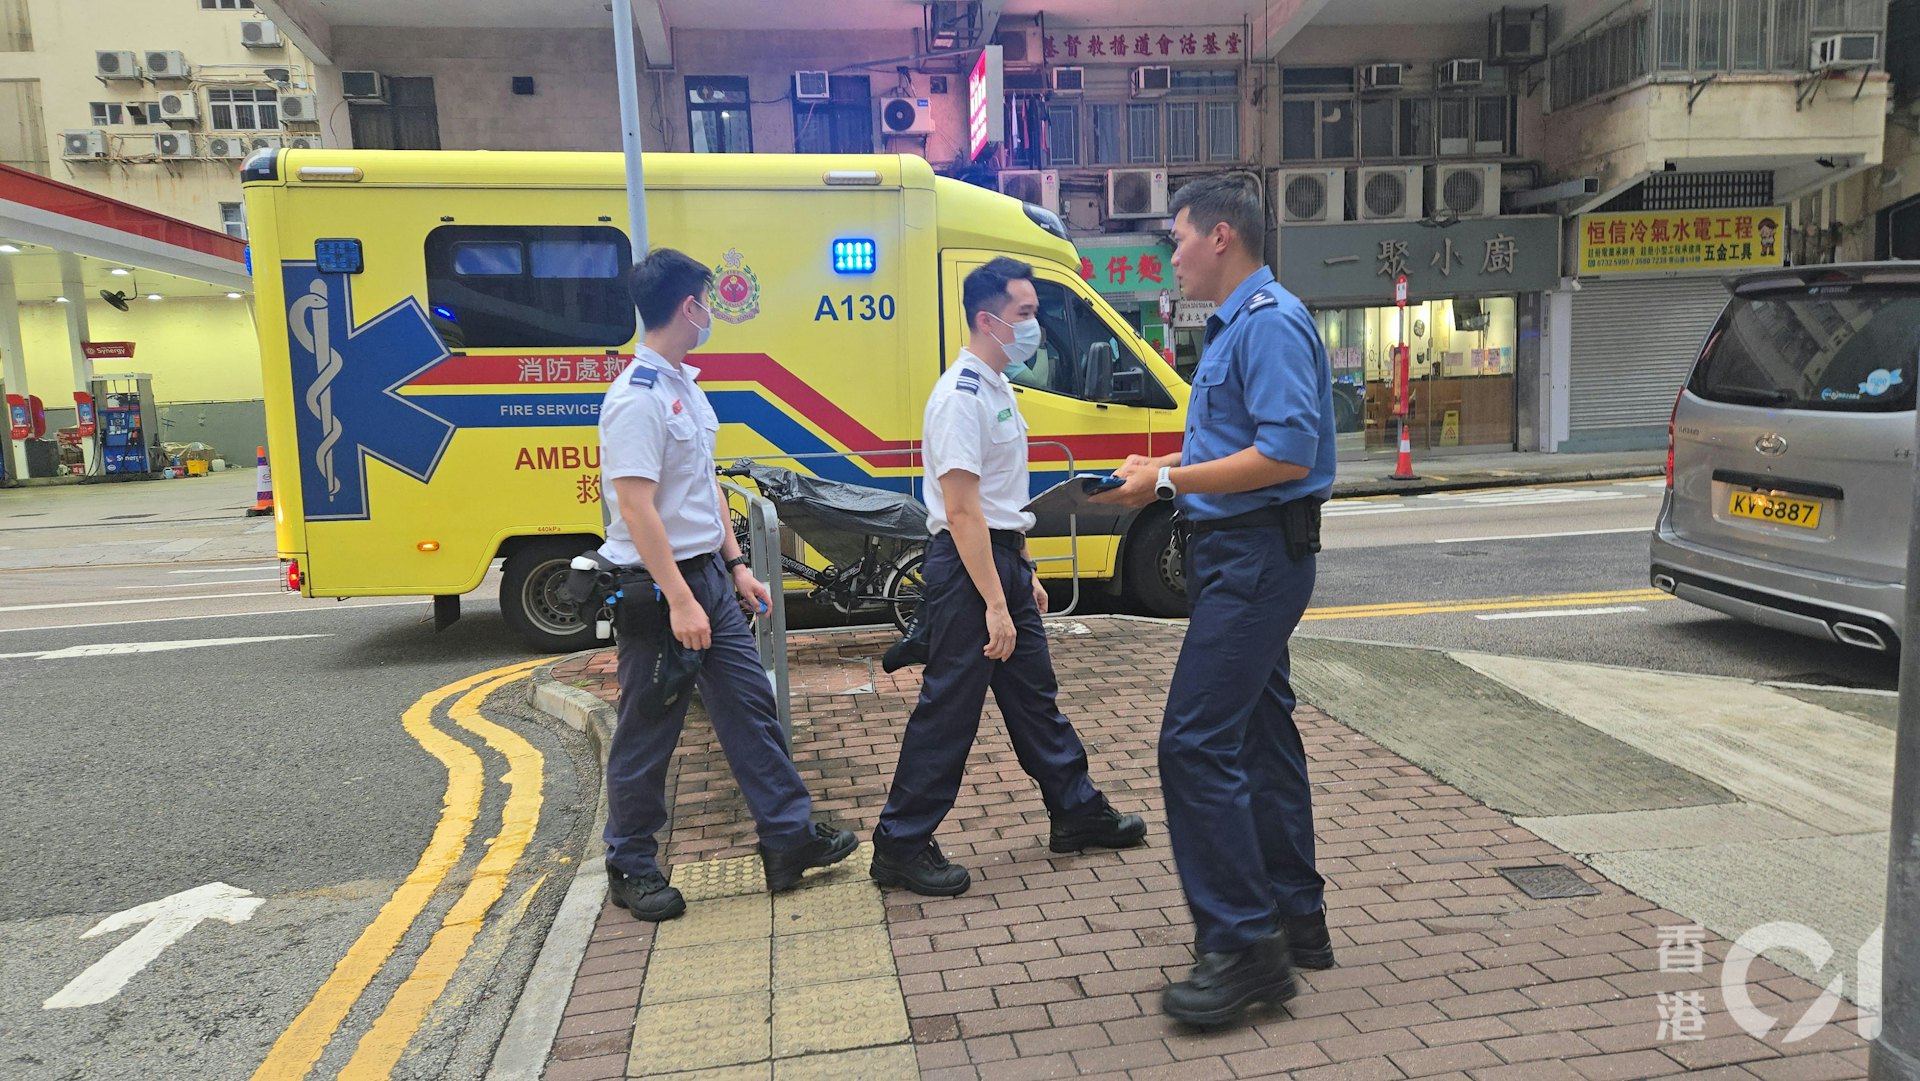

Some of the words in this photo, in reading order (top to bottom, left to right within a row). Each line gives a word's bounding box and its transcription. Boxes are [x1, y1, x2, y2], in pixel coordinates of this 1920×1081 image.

[1588, 215, 1753, 245] 恒信冷氣水電工程
[1323, 233, 1519, 280] 一聚小廚
[1704, 242, 1752, 261] 五金工具
[814, 294, 896, 321] A130
[96, 347, 126, 355] Synergy
[500, 405, 533, 416] FIRE
[1734, 495, 1757, 514] KV
[1762, 499, 1814, 524] 8887
